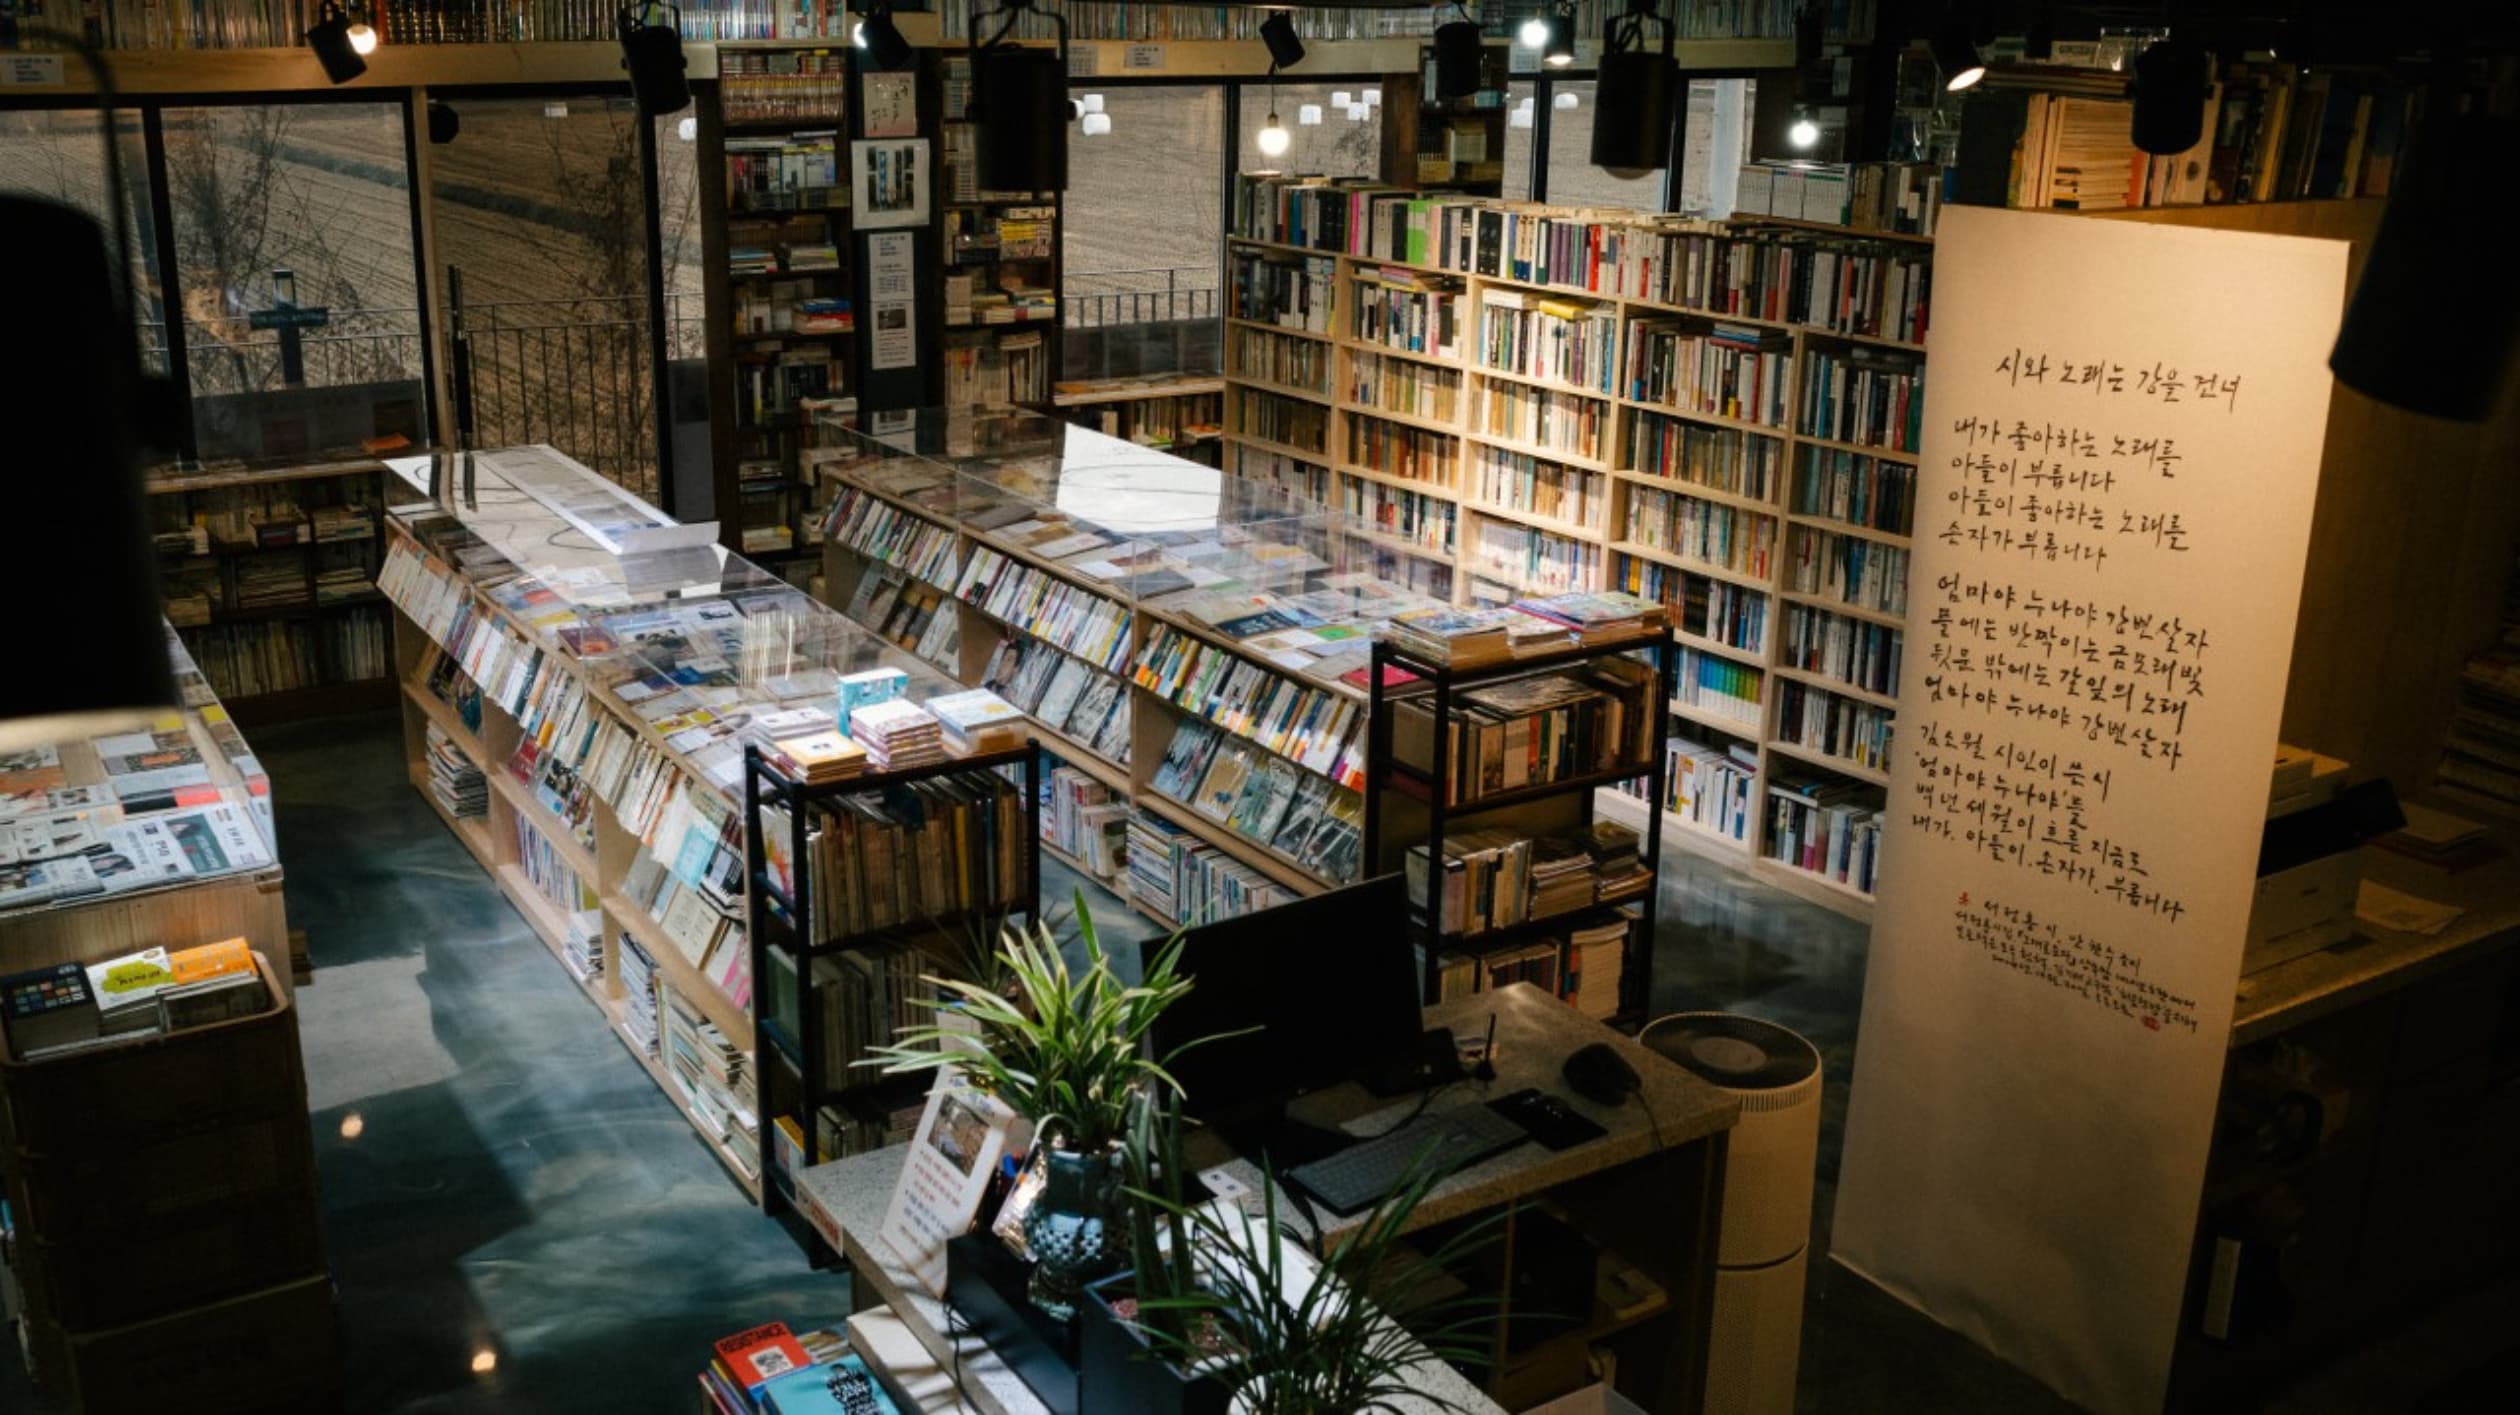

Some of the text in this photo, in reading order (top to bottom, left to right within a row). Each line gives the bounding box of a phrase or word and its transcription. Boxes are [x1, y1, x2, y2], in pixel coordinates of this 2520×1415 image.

[1995, 348, 2241, 413] 시와 노래는 강을 건너
[1952, 453, 2016, 486] 아들이
[1954, 416, 2182, 478] 내가 좋아하는 노래를
[1938, 521, 2013, 551] 손자가
[1949, 487, 2189, 551] 아들이 좋아하는 노래를
[1938, 572, 2016, 608] 엄마야
[2024, 590, 2097, 626] 누나야
[2009, 620, 2100, 663] 반짝이는
[1925, 674, 1998, 713] 엄마야
[2005, 693, 2071, 727] 누나야
[1930, 643, 2188, 734] 뒷문 밖에는 갈잎의 노래
[1920, 721, 2112, 803] 김소월 시인이 쓴 시
[1966, 799, 2034, 840] 세월이
[2090, 838, 2148, 877] 지금도
